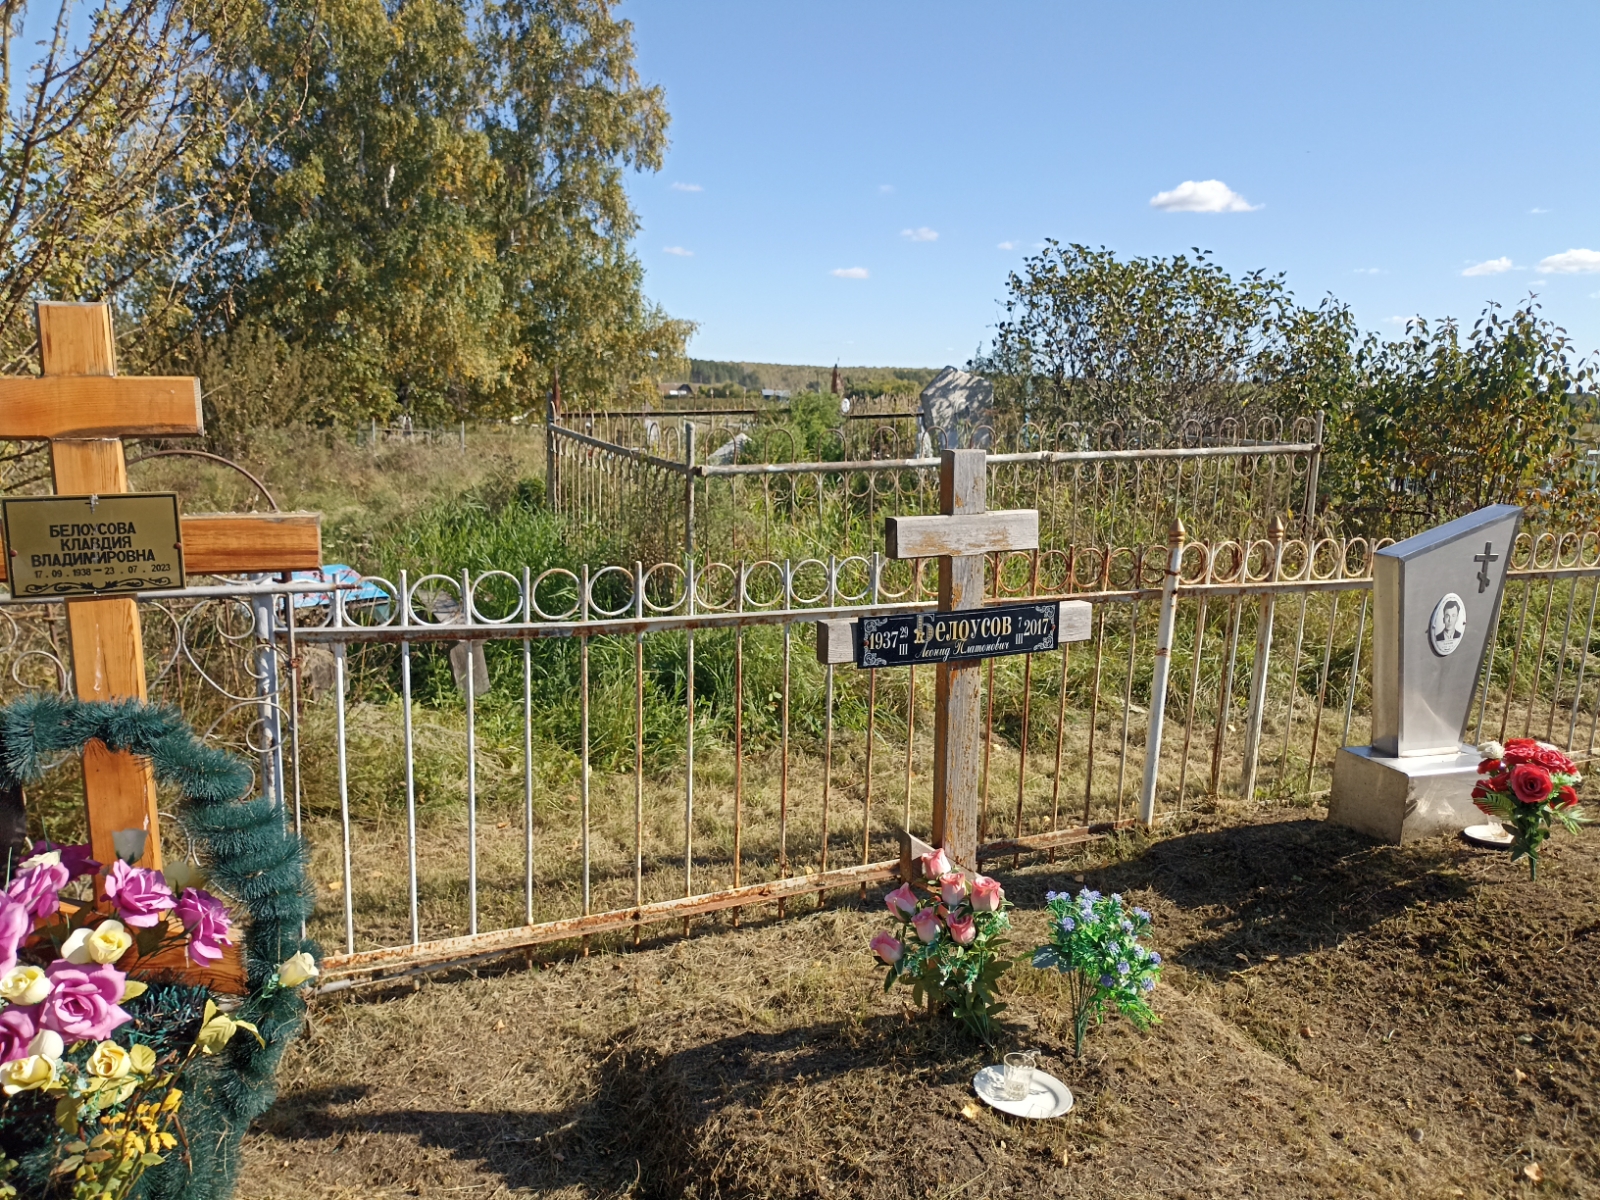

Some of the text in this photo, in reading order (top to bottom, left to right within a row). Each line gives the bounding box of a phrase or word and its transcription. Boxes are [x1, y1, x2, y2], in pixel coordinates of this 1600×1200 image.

[49, 522, 136, 538] БЕЛОУСОВА
[60, 536, 132, 551] КЛАВДИЯ
[31, 549, 156, 568] ВЛАДИМИРОВНА
[869, 614, 1049, 650] 1937 Белоусов 2017
[900, 626, 909, 639] 29
[915, 636, 1010, 662] Леонид Платонович
